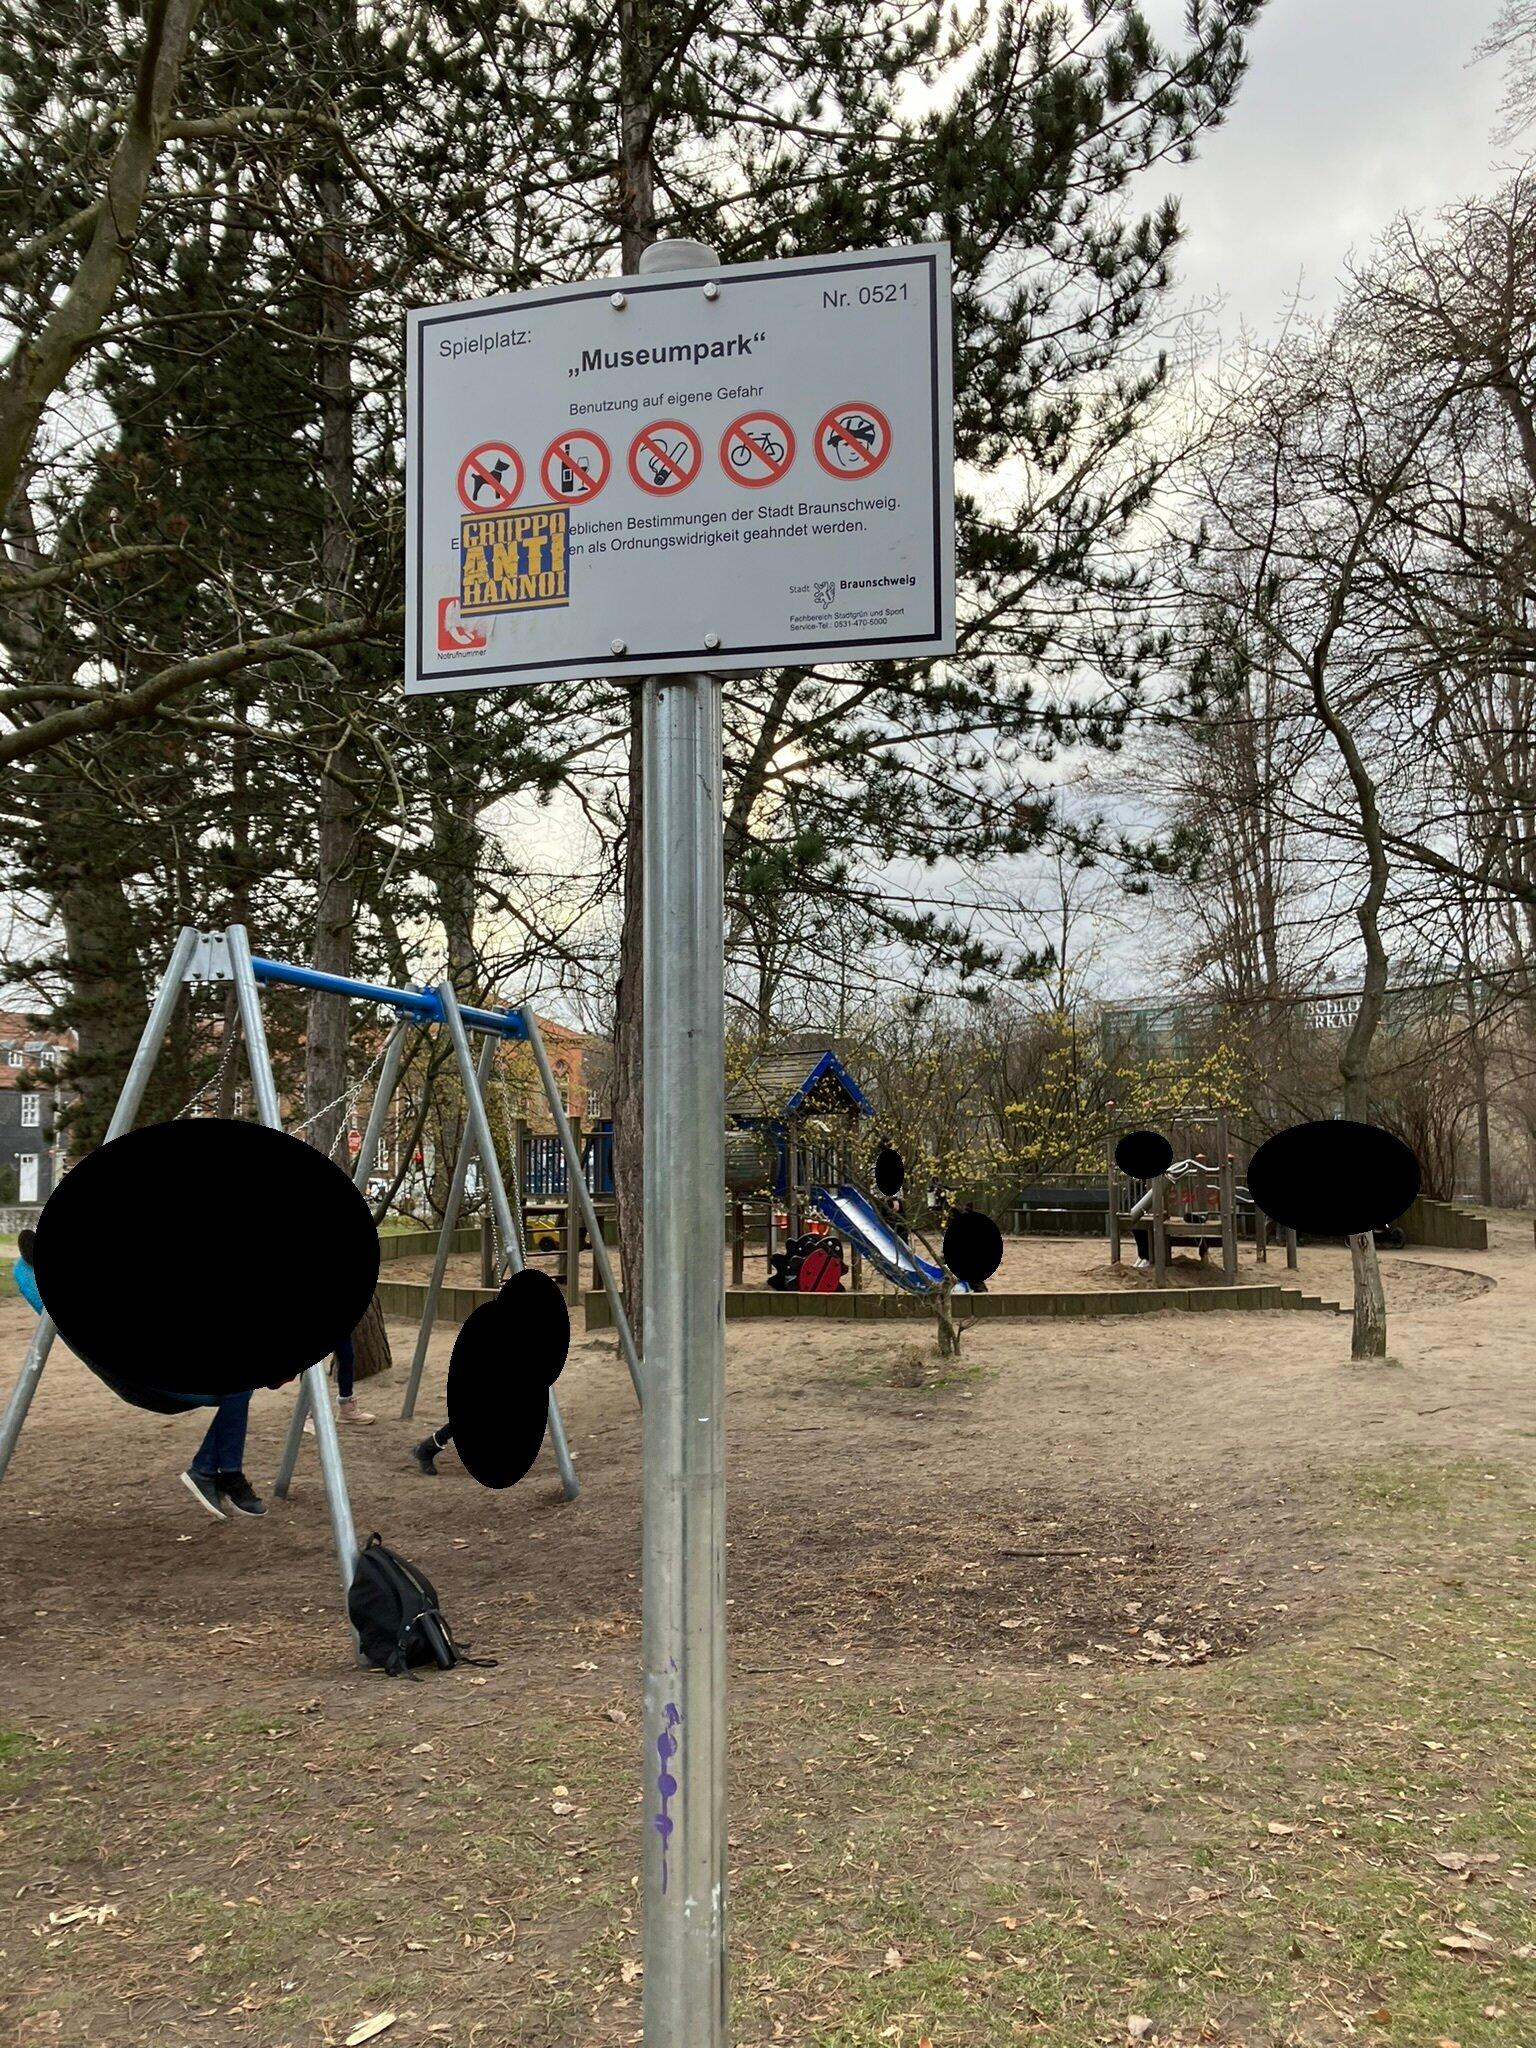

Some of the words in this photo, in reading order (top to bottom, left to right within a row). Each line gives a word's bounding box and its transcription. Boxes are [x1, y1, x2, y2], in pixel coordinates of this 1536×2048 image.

[823, 289, 850, 308] Nr.
[858, 283, 909, 305] 0521
[439, 329, 532, 359] Spielplatz:
[569, 396, 638, 415] Benutzung
[643, 393, 664, 407] auf
[668, 391, 712, 406] eigene
[717, 385, 764, 401] Gefahr
[569, 520, 623, 536] eblichen
[627, 511, 727, 530] Bestimmungen
[731, 508, 754, 521] der
[757, 505, 794, 519] Stadt
[798, 496, 901, 516] Braunschweig.
[568, 543, 585, 556] en
[588, 539, 607, 553] als
[610, 530, 740, 550] Ordnungswidrigkeit
[743, 524, 808, 543] geahndet
[811, 519, 867, 535] werden.
[463, 532, 566, 586] ANTI
[463, 570, 567, 606] HANNOI
[789, 584, 810, 594] Stadt
[840, 574, 916, 590] Braunschweig
[789, 613, 832, 623] Fachbereich
[834, 610, 868, 621] Stadtgrün
[869, 609, 884, 617] und
[885, 607, 905, 617] Sport
[833, 617, 888, 629] 0531-470-5000
[437, 648, 487, 660] Notrufnummer
[1305, 998, 1363, 1015] SCHLO
[1304, 1012, 1359, 1030] ARKAD
